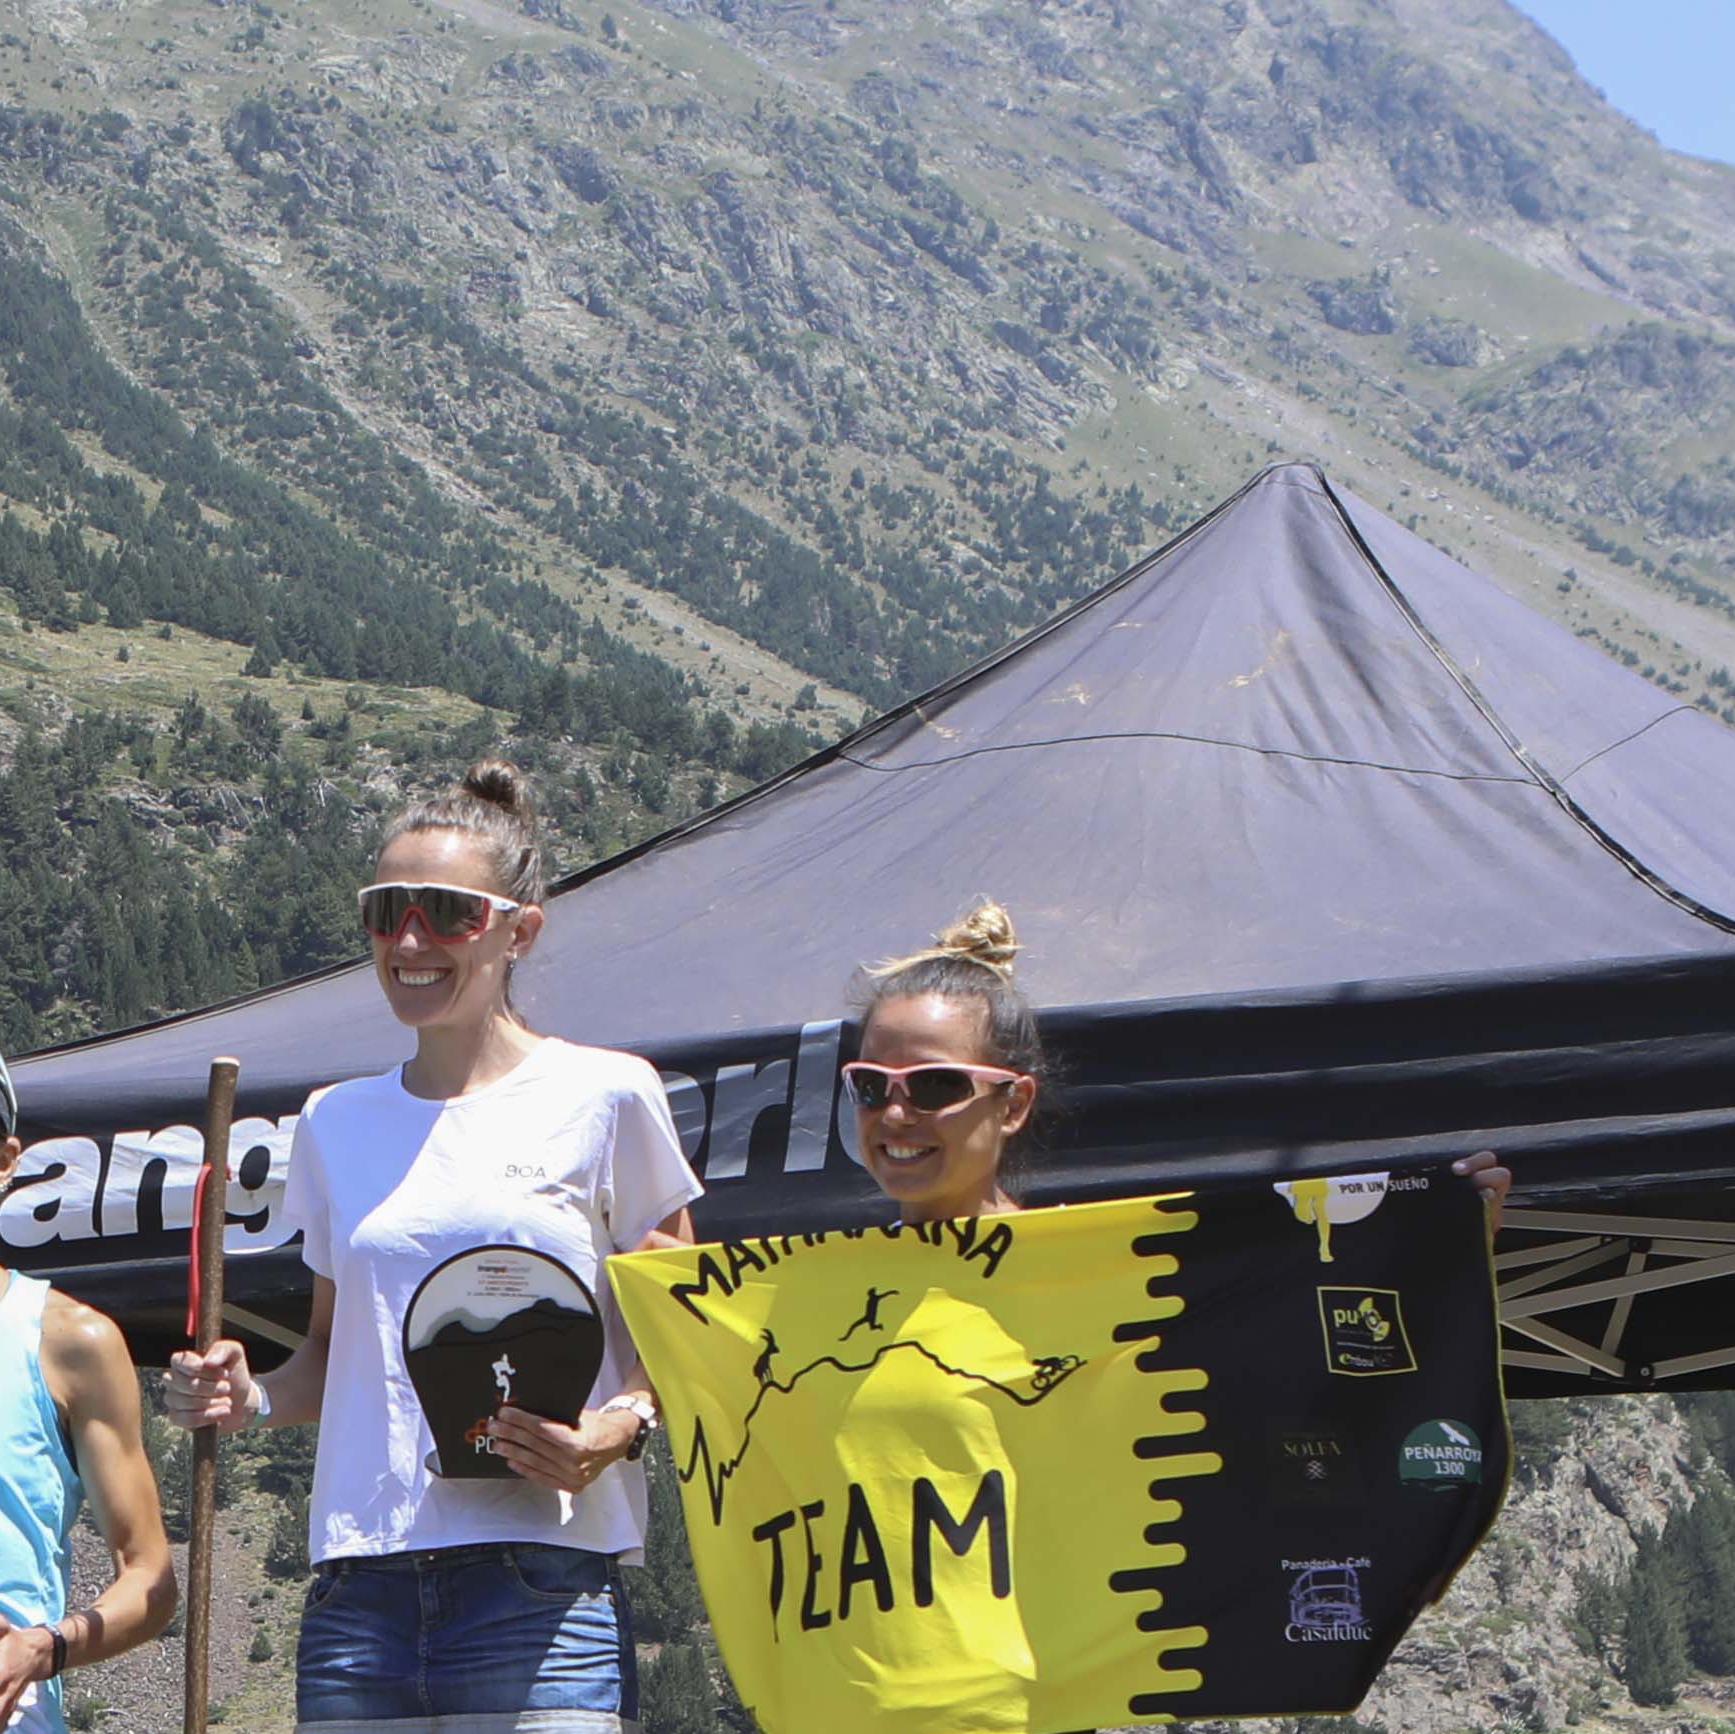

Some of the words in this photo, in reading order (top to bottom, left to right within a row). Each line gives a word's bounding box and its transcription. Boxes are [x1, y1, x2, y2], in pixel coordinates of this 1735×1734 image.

[1339, 1182, 1364, 1195] POR
[1367, 1180, 1385, 1193] UN
[1390, 1176, 1430, 1192] SUEÑO
[1434, 1460, 1466, 1476] 1300
[752, 1469, 1012, 1644] TEAM
